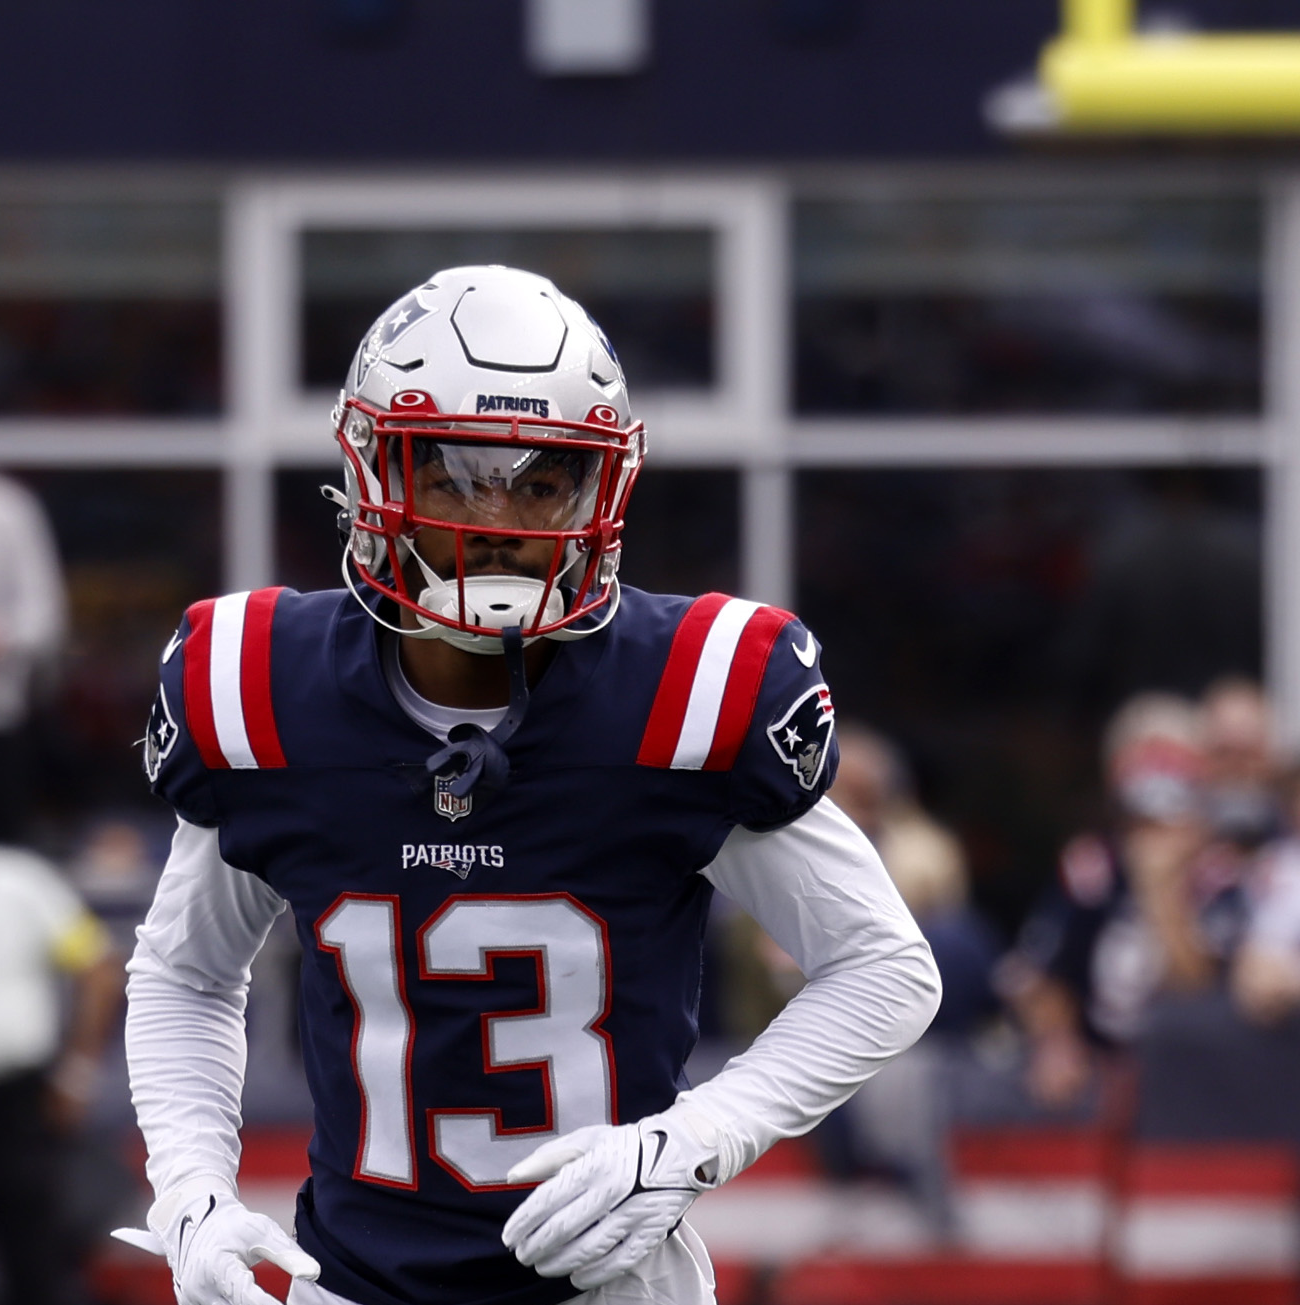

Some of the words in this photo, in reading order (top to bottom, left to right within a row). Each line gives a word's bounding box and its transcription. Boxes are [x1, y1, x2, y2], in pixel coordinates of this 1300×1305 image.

[476, 394, 549, 418] PATRIOTS
[440, 793, 467, 812] NFL
[401, 843, 505, 869] PATRIOTS
[314, 891, 619, 1193] 13
